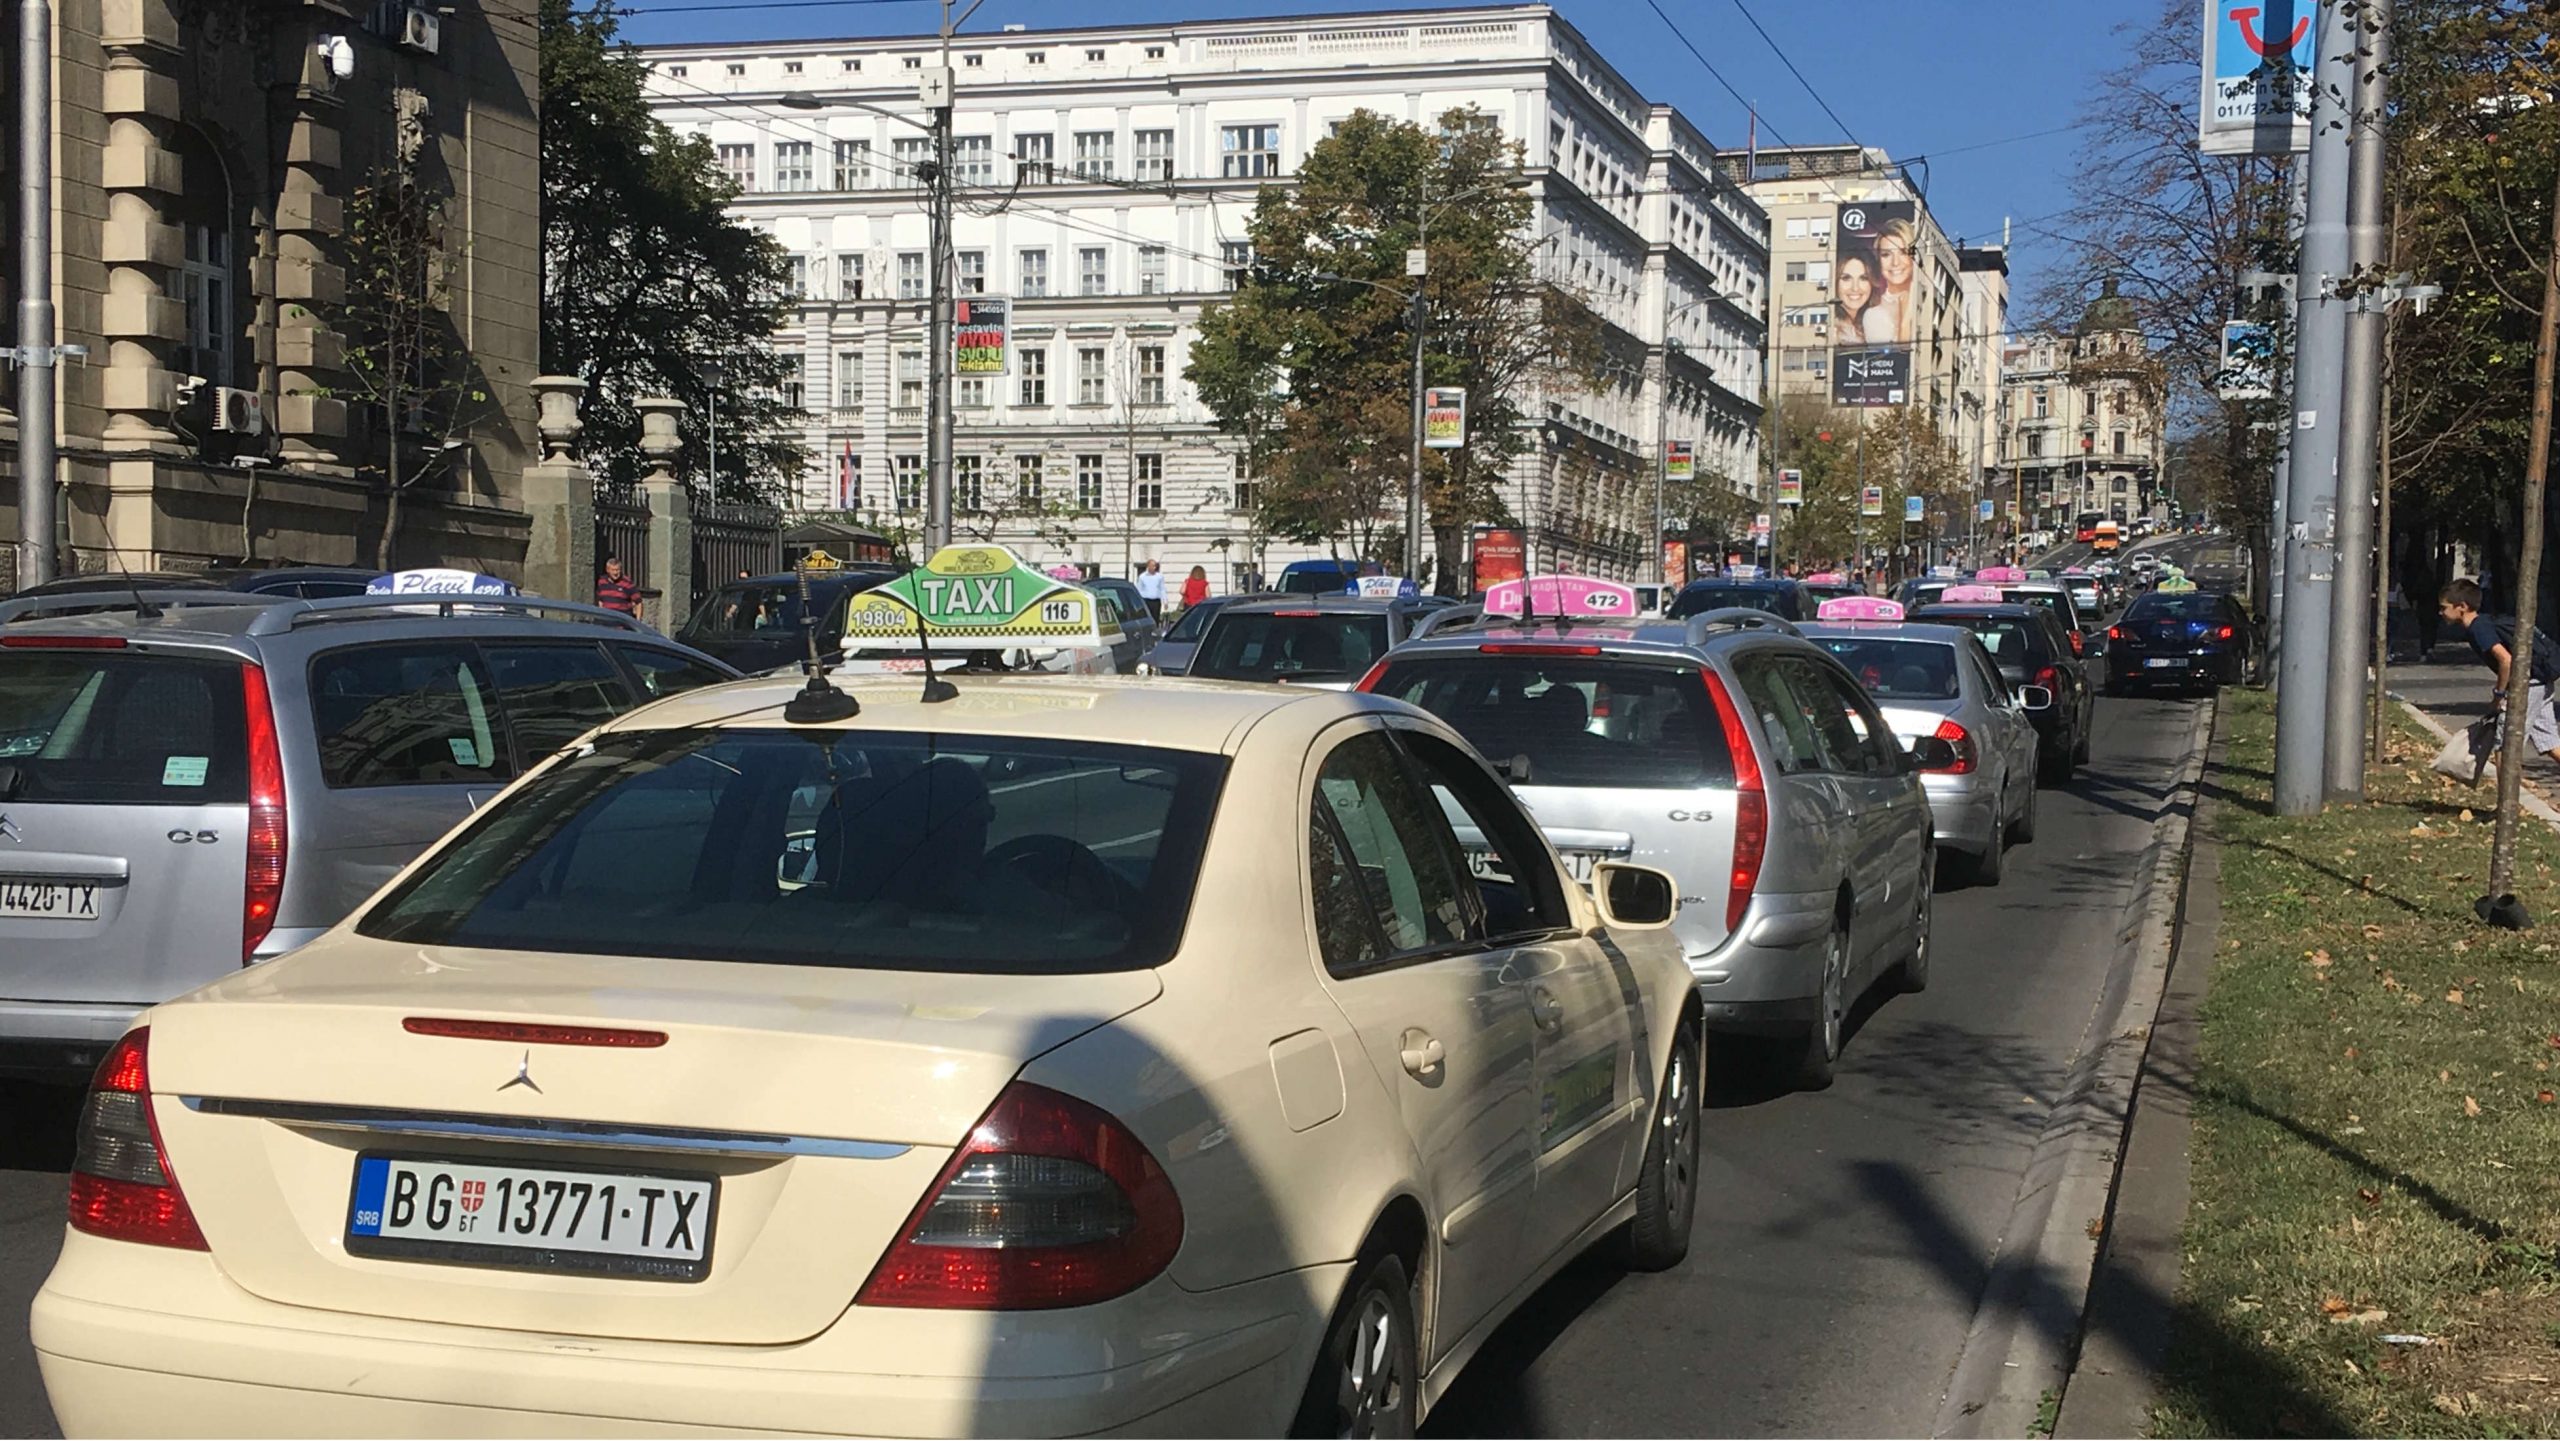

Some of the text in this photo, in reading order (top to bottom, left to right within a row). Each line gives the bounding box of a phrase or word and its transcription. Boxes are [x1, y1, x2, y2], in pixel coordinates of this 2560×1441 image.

[958, 332, 1004, 348] OVDE
[402, 573, 468, 593] Plavi
[1532, 581, 1588, 592] RADIO TAXI
[921, 577, 1014, 615] TAXI
[1586, 594, 1619, 607] 472
[852, 608, 907, 628] 19804
[1045, 601, 1070, 620] 116
[1668, 809, 1713, 822] C5
[167, 828, 219, 844] C5
[389, 1170, 455, 1231] BG
[355, 1209, 379, 1226] SRB
